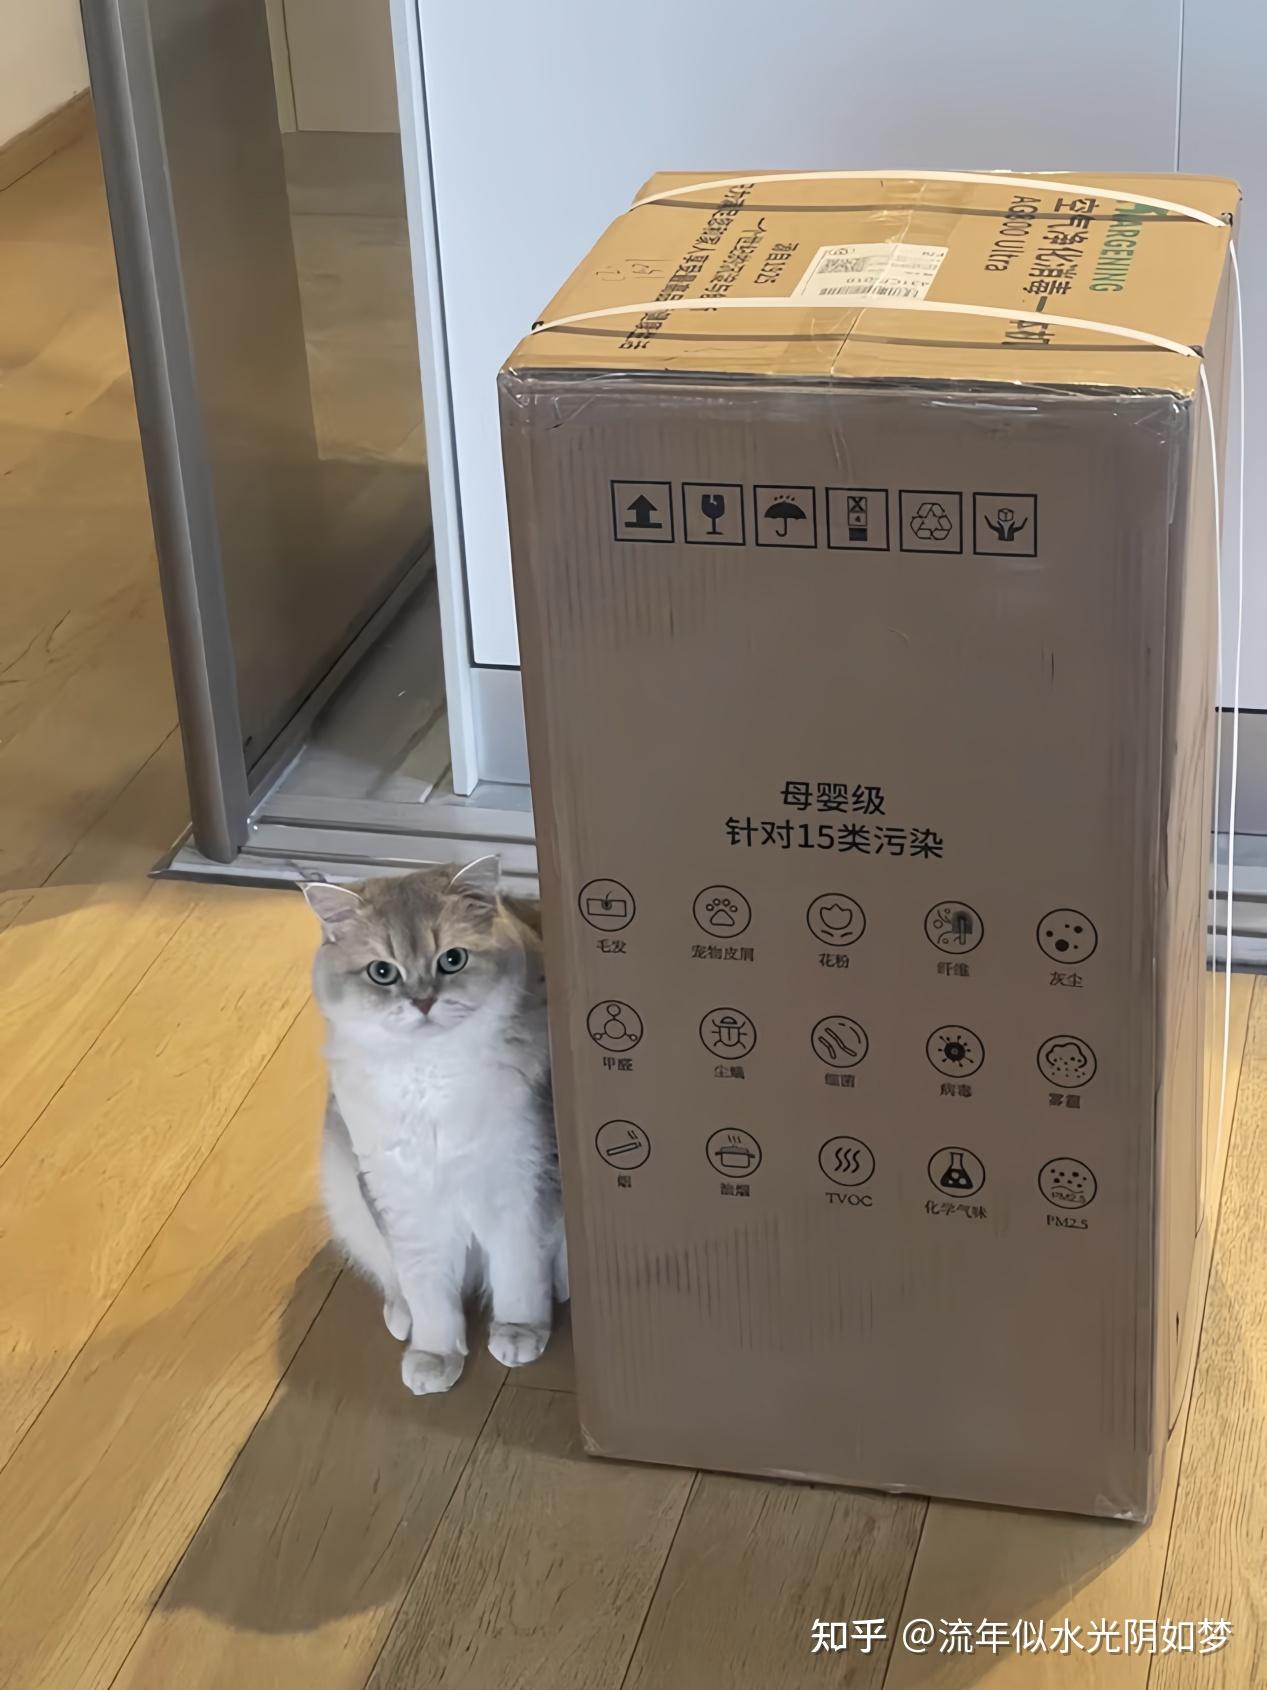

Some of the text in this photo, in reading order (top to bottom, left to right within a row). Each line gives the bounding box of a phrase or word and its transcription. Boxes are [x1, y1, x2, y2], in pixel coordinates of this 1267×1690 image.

[984, 239, 1025, 272] Ultra
[780, 781, 886, 815] 母婴级
[725, 817, 944, 859] 针对15类污染
[596, 939, 627, 954] 毛发
[819, 953, 850, 968] 花粉
[1050, 972, 1084, 988] 灰尘
[825, 1192, 873, 1207] TVOC
[924, 1200, 988, 1219] 化学气味
